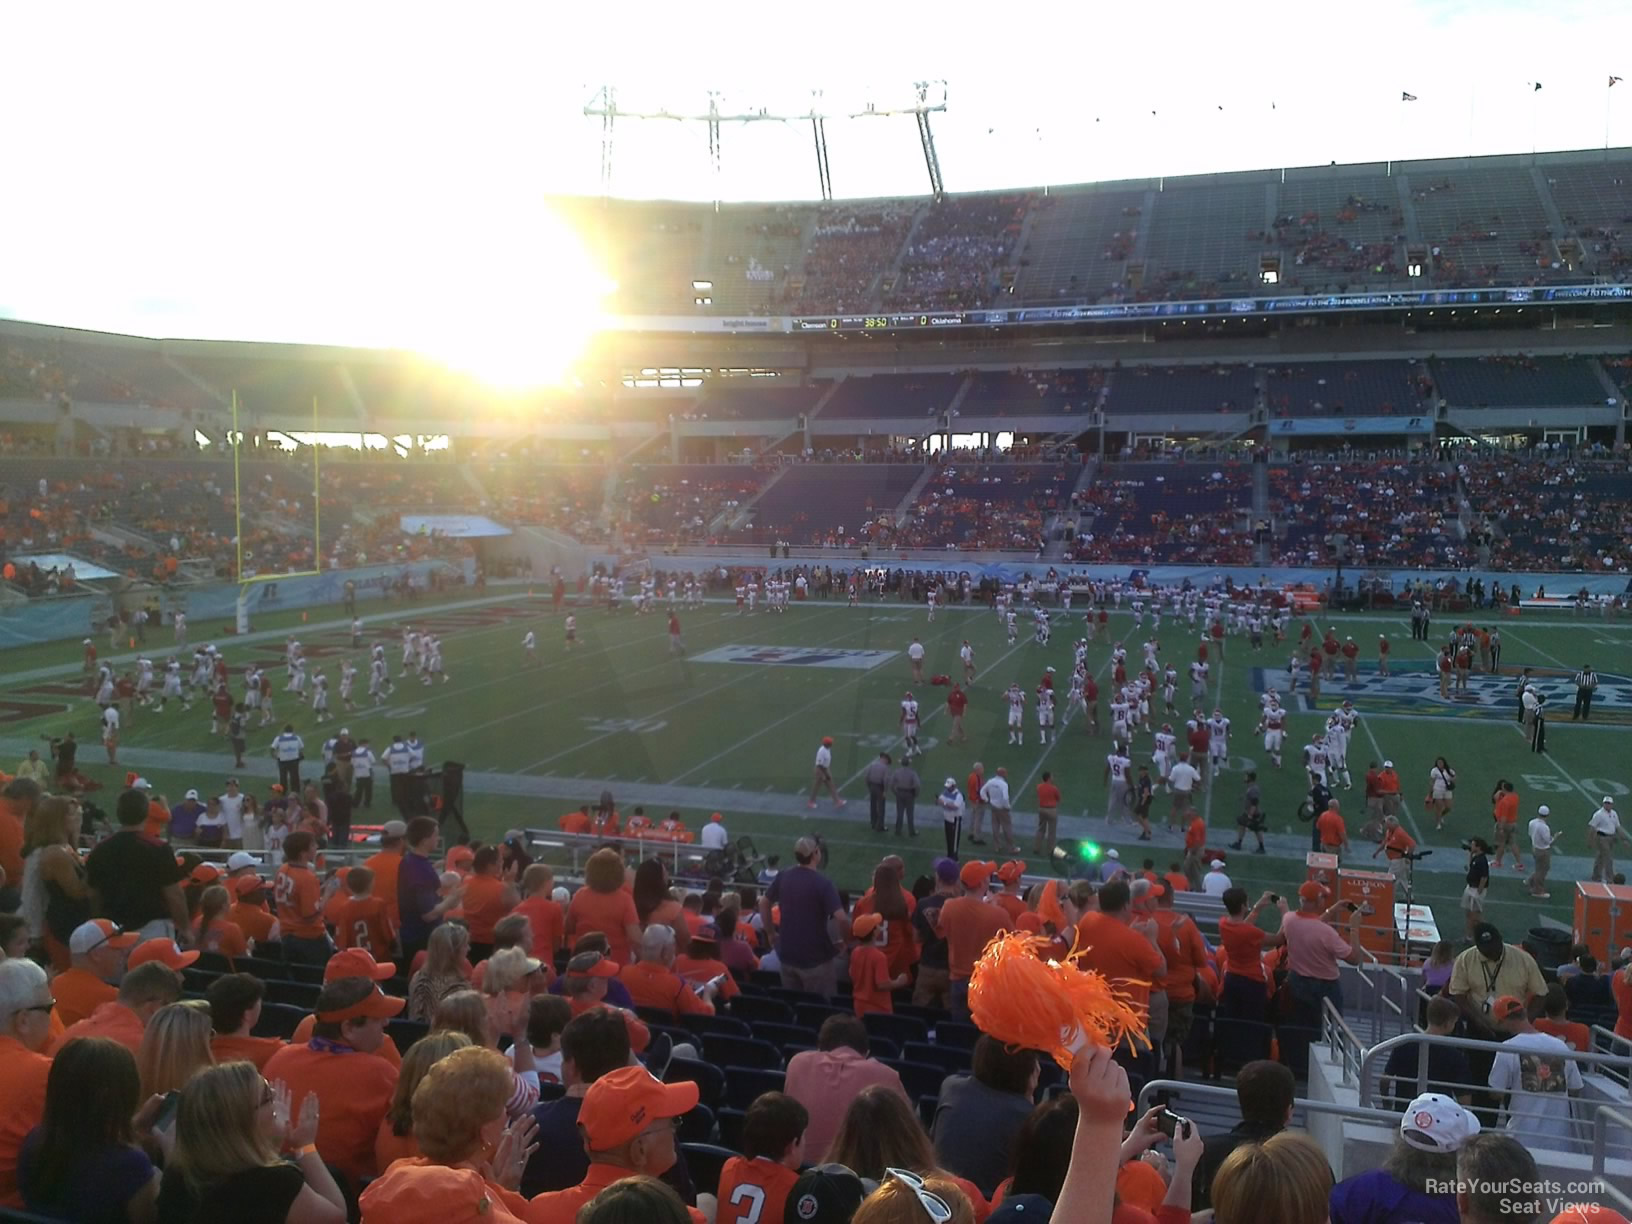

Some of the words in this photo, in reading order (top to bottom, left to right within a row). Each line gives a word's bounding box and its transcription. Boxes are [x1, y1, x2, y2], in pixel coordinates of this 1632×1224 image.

[830, 319, 837, 328] 0
[920, 315, 927, 325] 0
[931, 317, 962, 325] Oklahoma
[1520, 774, 1631, 796] 50
[1347, 879, 1387, 889] CLEMSON
